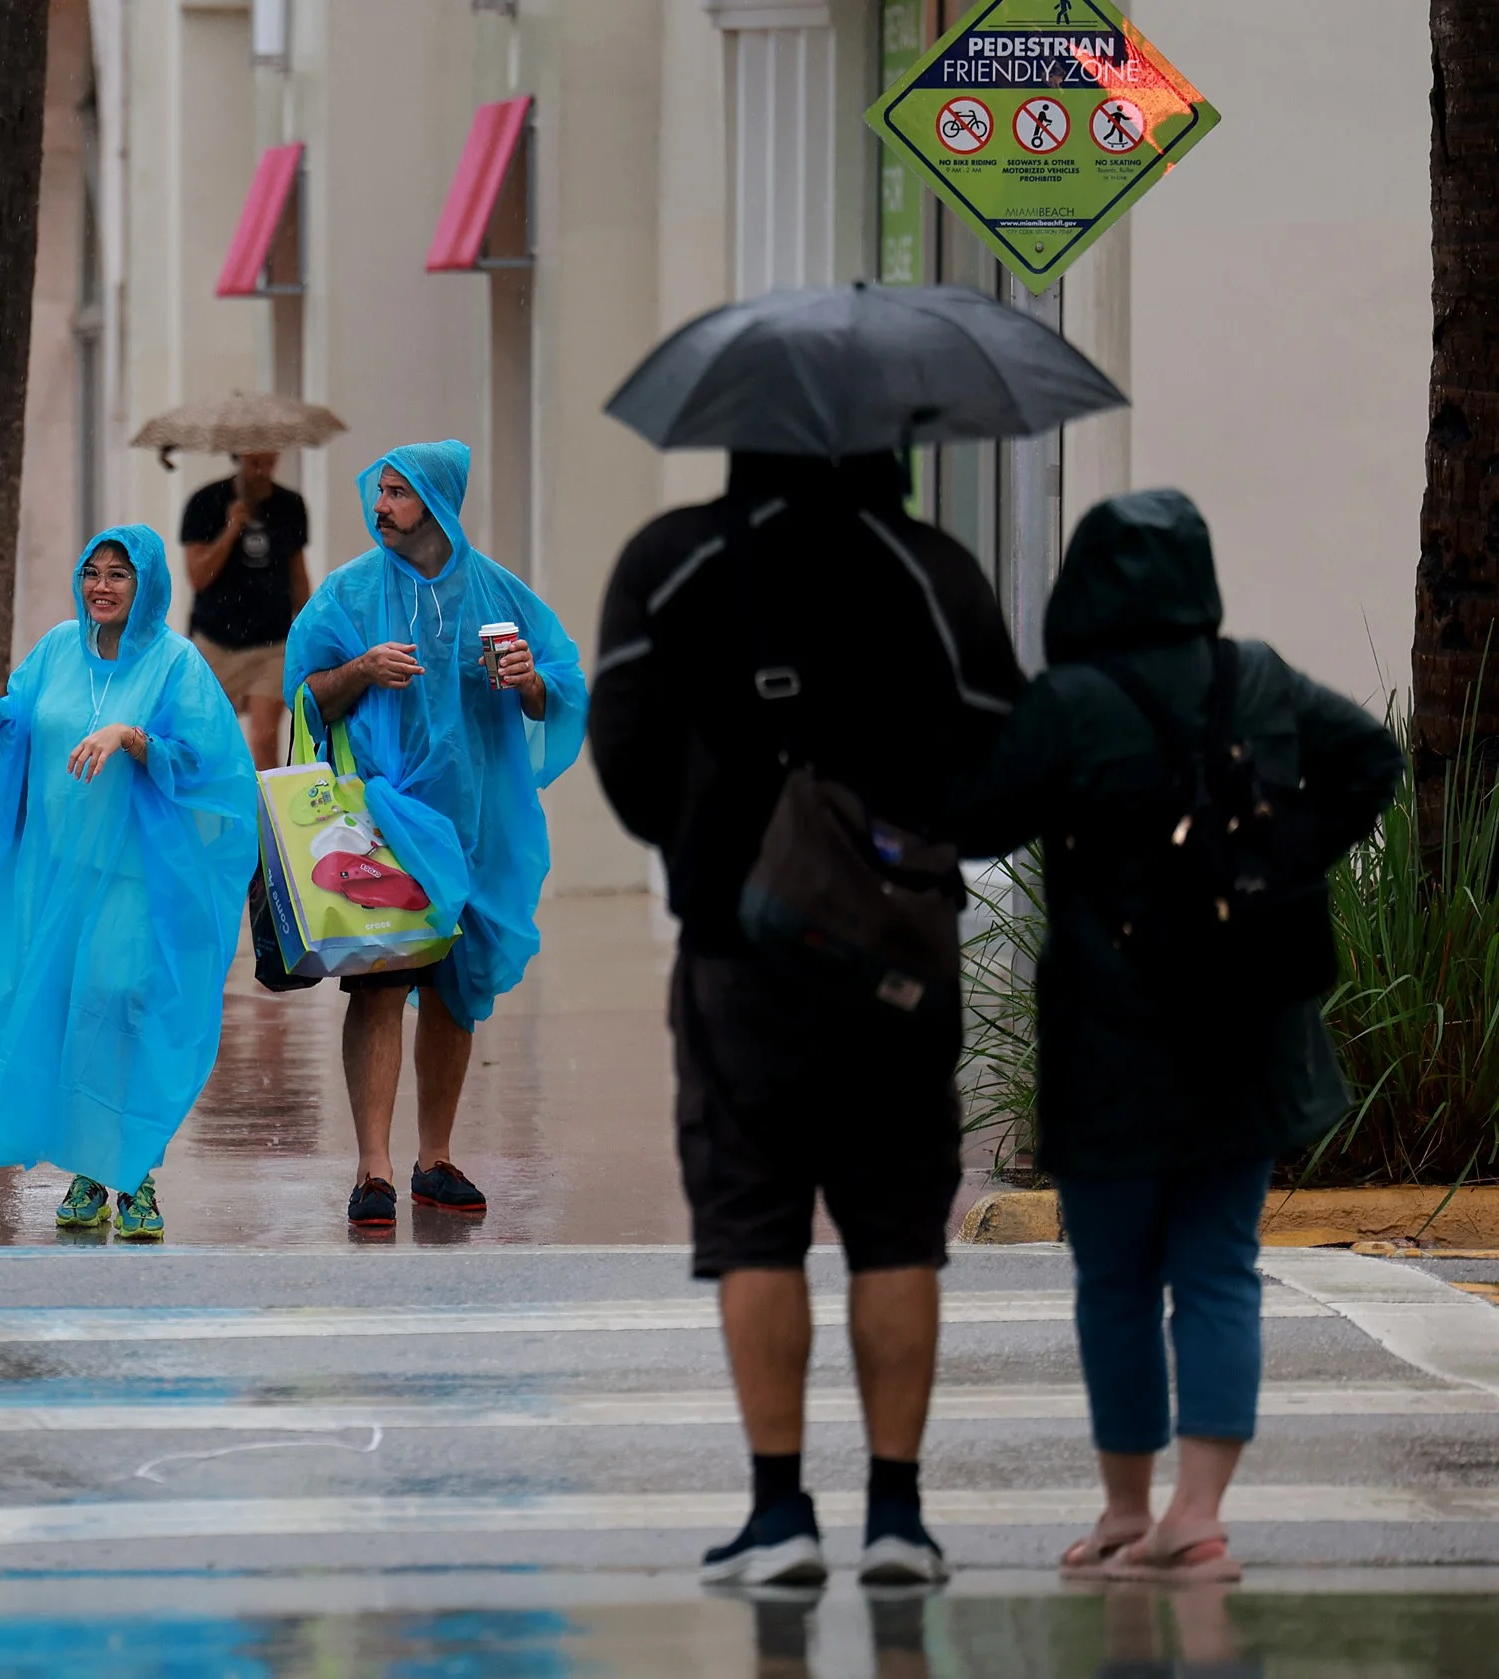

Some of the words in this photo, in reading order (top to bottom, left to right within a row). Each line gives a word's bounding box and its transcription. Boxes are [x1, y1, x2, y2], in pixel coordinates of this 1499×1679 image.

[968, 37, 1115, 57] PEDESTRIAN
[943, 60, 1056, 82] FRIENDLY
[1064, 60, 1139, 82] ZONE
[365, 920, 392, 930] crocs
